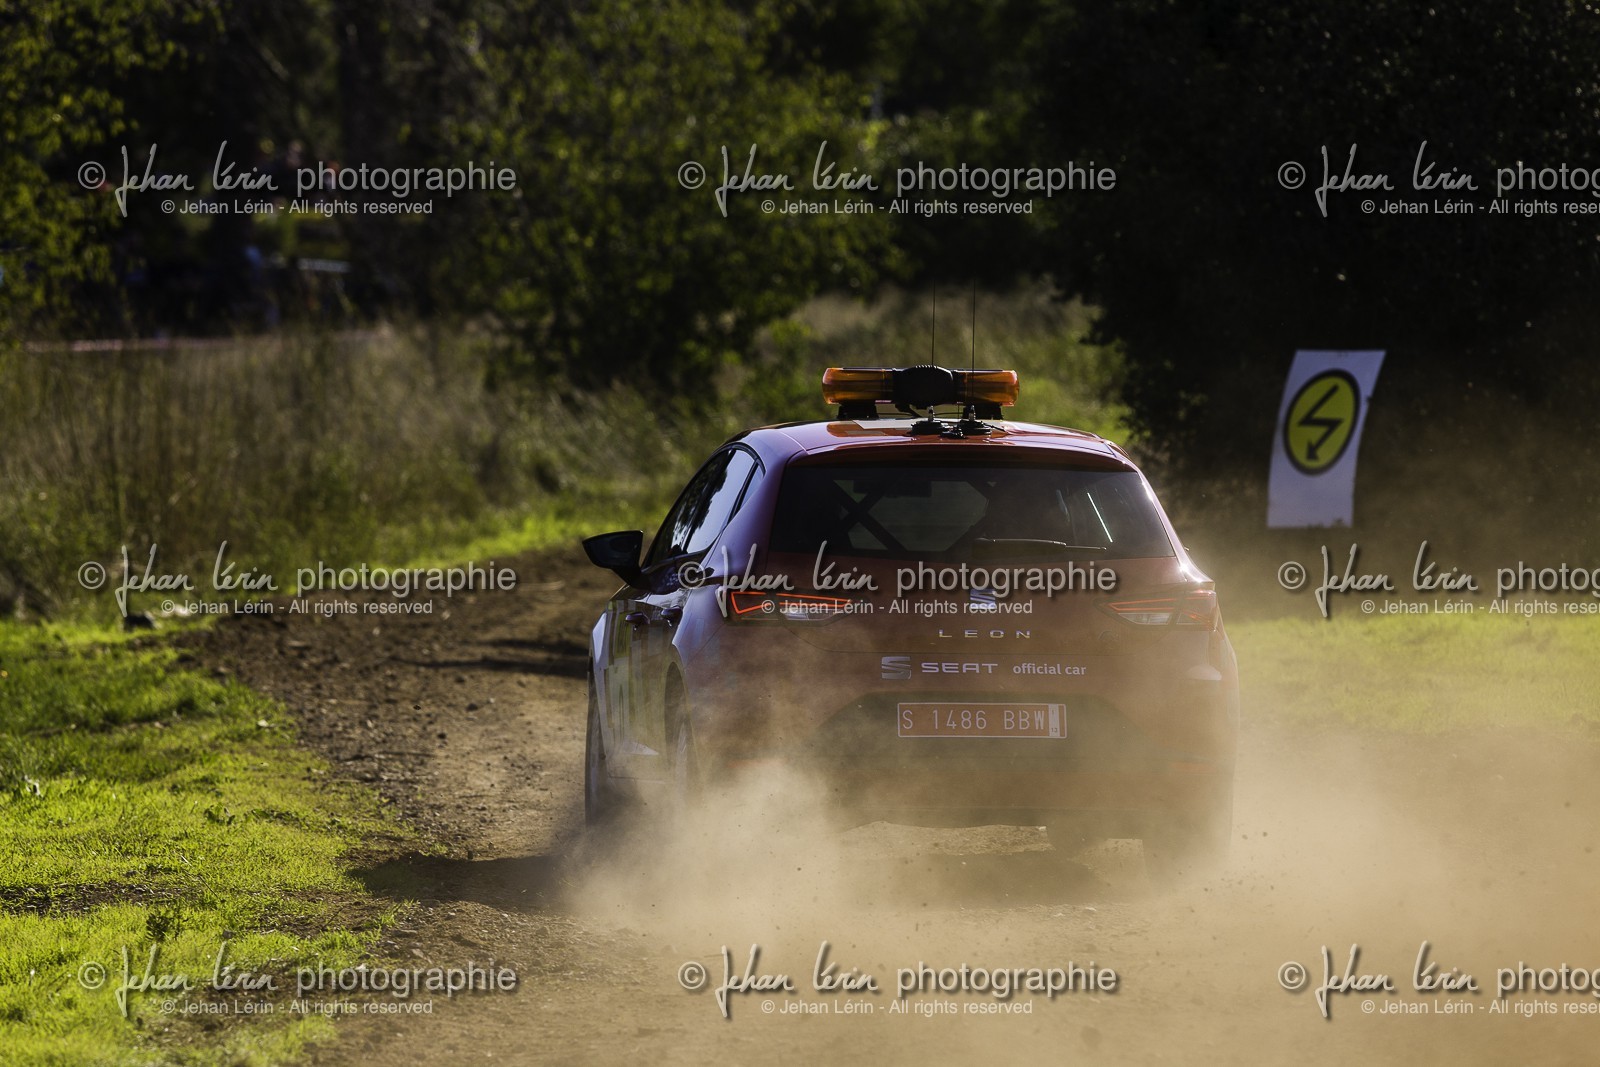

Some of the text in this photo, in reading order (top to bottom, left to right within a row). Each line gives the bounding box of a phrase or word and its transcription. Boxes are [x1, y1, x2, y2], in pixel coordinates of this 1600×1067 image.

[938, 629, 1031, 639] LEON
[921, 662, 998, 674] SEAT
[1012, 662, 1062, 675] official
[1065, 665, 1087, 675] car
[902, 709, 1045, 730] S 1486 BBW
